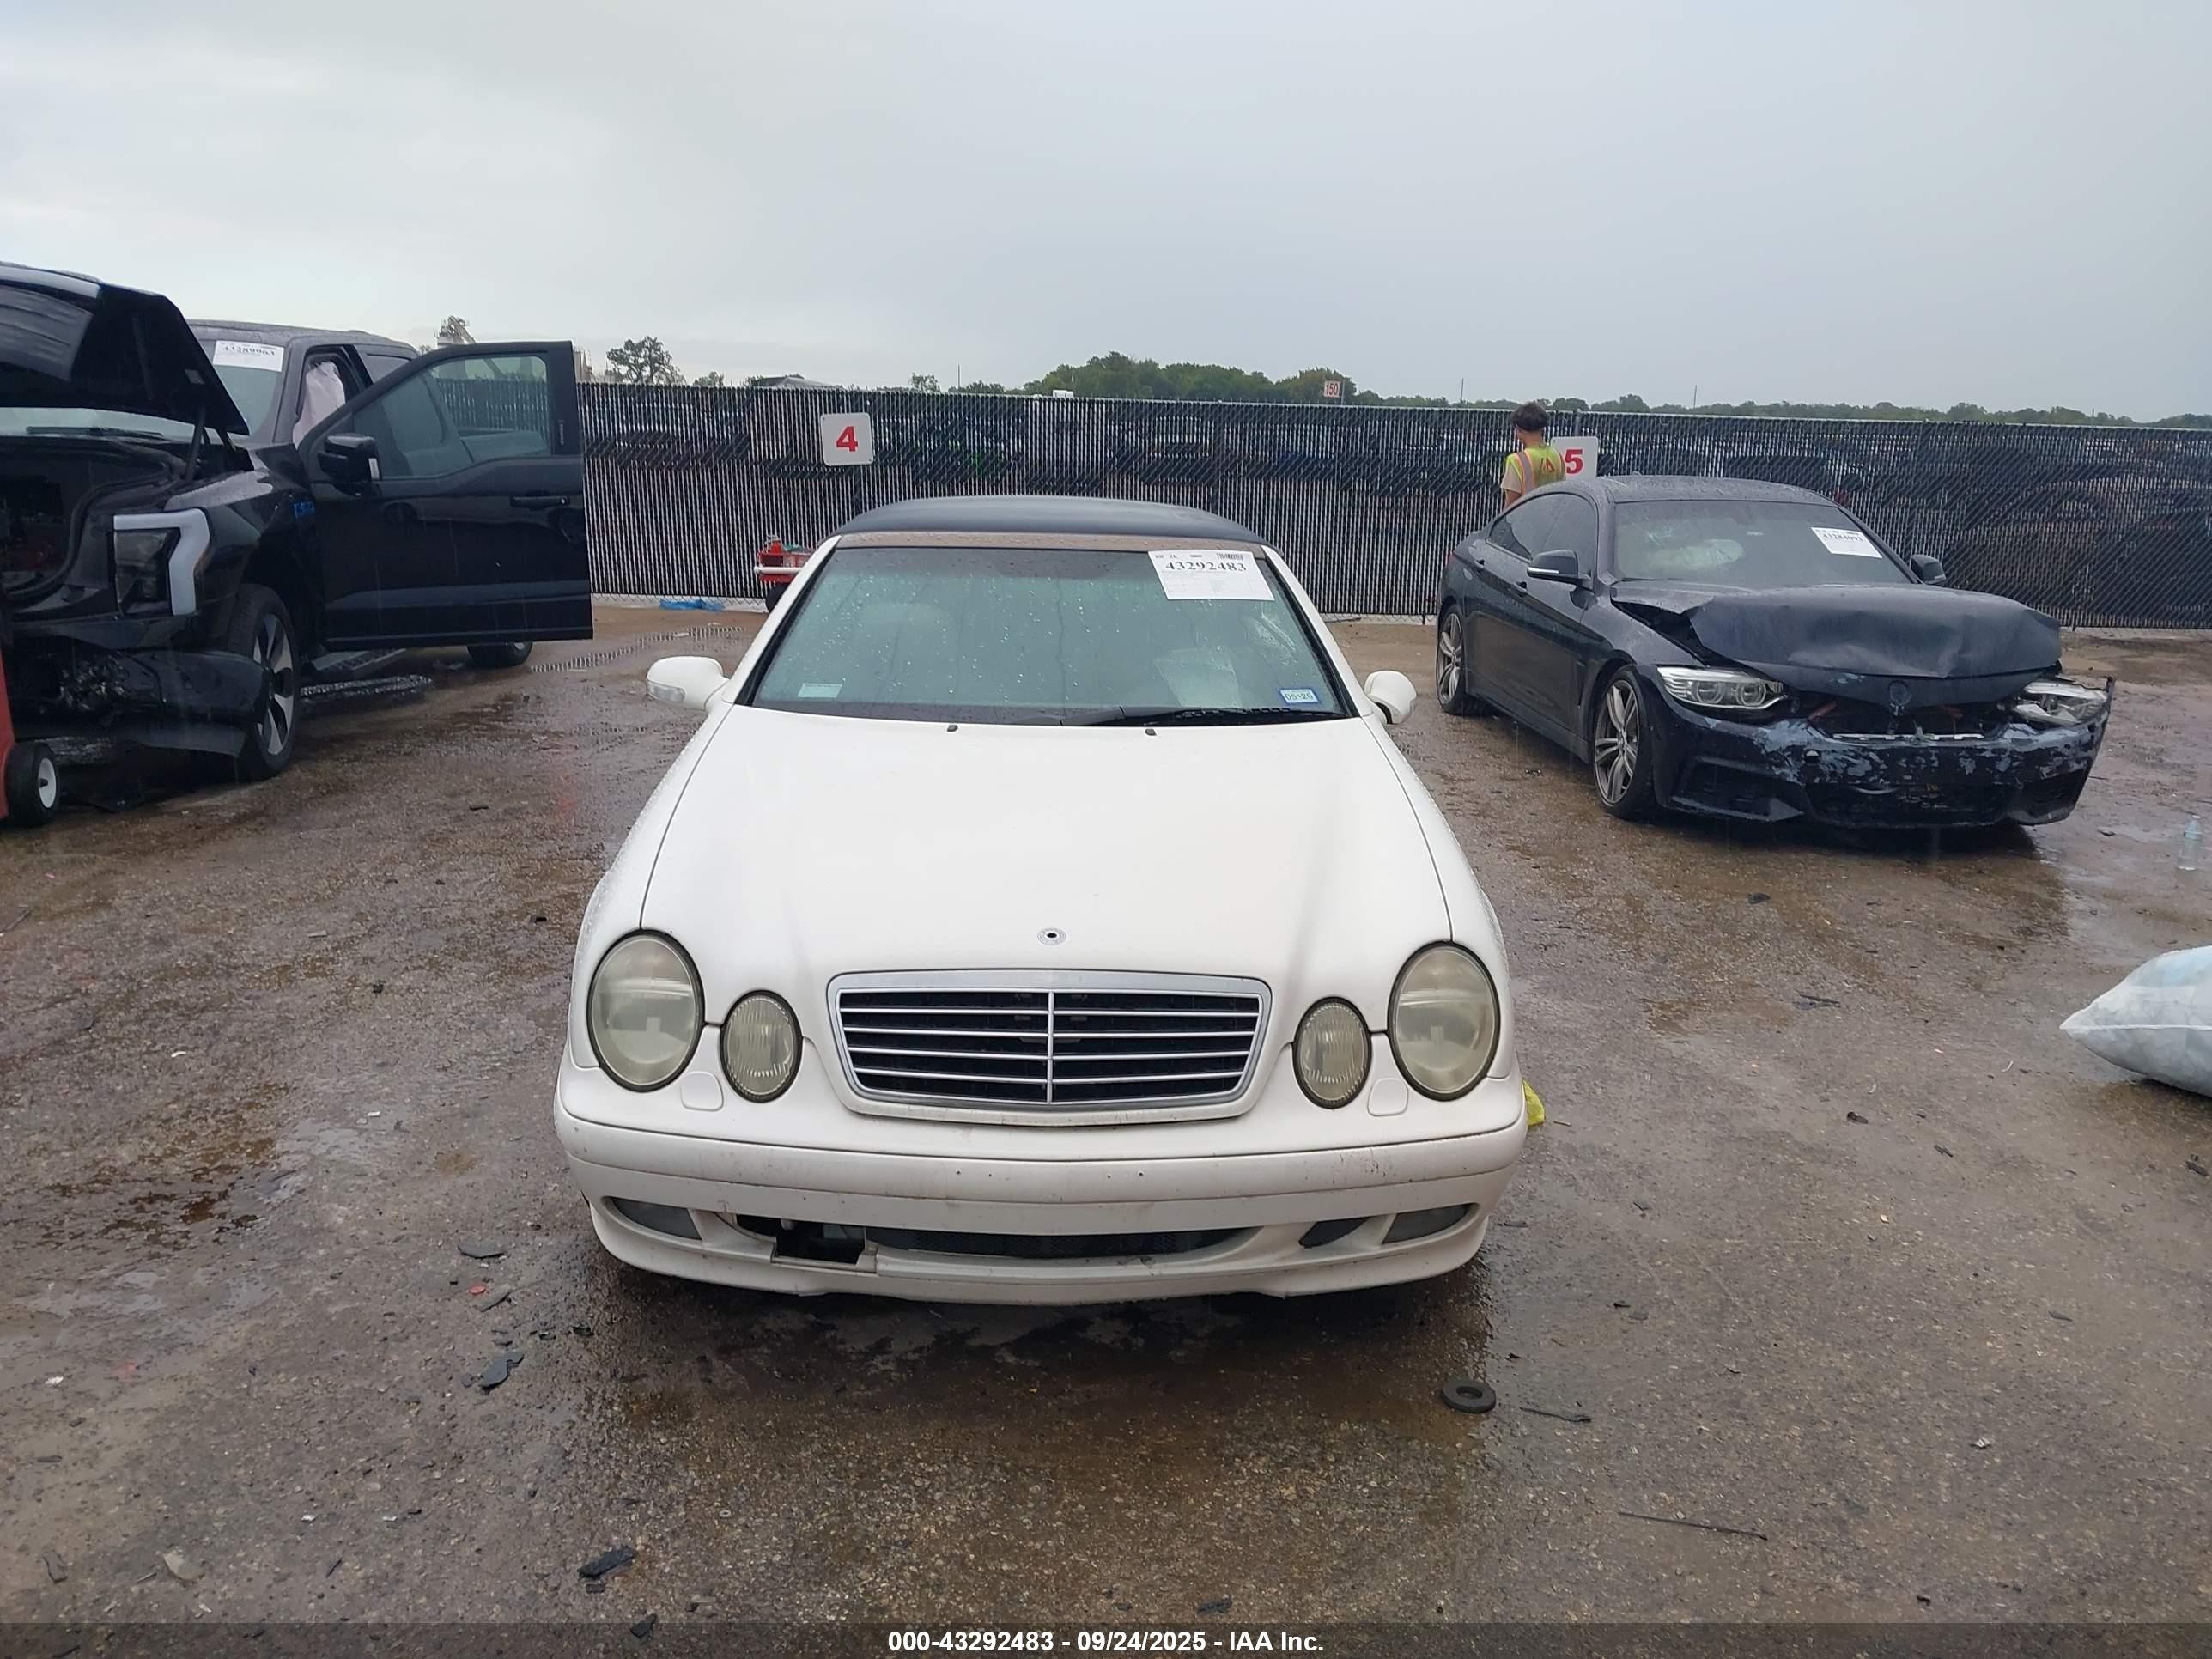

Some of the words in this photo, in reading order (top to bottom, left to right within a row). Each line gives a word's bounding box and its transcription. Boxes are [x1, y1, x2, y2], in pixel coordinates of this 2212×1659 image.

[1326, 383, 1338, 395] 150
[836, 426, 858, 452] 4
[1565, 449, 1583, 474] 5
[1166, 562, 1247, 572] 43292483
